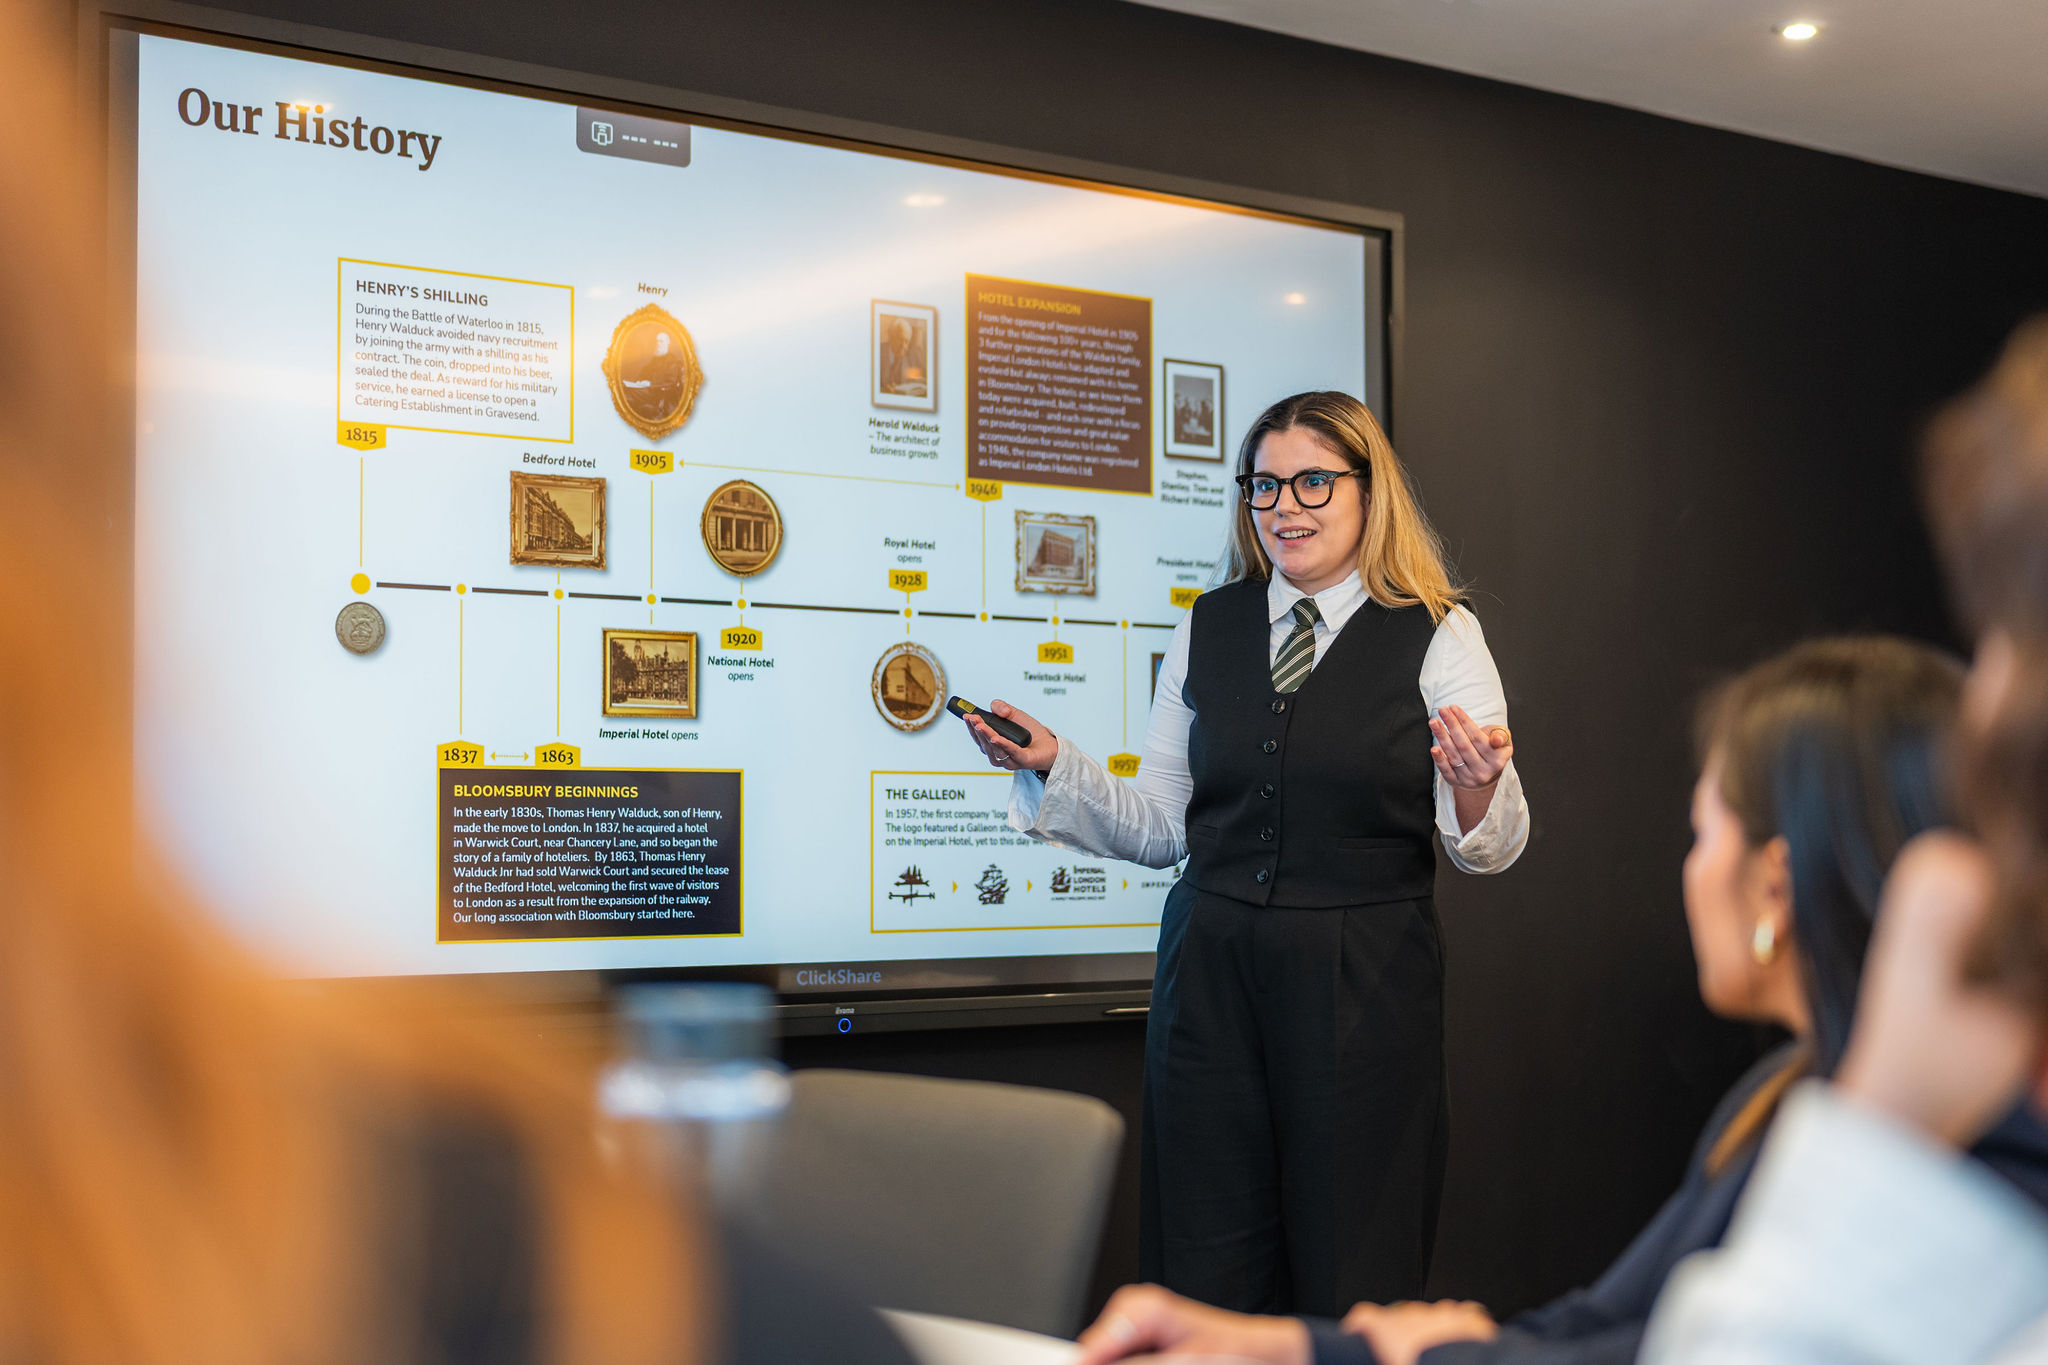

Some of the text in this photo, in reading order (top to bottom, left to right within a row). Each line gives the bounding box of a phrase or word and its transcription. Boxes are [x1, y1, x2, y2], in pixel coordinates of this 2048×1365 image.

[177, 87, 442, 171] Our History
[356, 281, 488, 307] HENRY'S SHILLING
[638, 282, 668, 297] Henry
[977, 293, 1081, 315] HOTEL EXPANSION
[355, 303, 544, 336] During the Battle of Waterloo in 1815,
[355, 318, 557, 350] Henry Walduck avoided navy recruitment
[354, 351, 552, 381] contract. The coin, dropped into his beer,
[354, 394, 539, 421] Catering Establishment in Gravesend.
[868, 418, 940, 432] Harold Walduck
[346, 428, 378, 444] 1815
[876, 432, 892, 441] The
[894, 434, 930, 445] architect
[932, 437, 940, 446] of
[870, 446, 938, 460] business growth
[523, 453, 596, 468] Bedford Hotel
[635, 454, 666, 468] 1905
[970, 483, 998, 496] 1946
[884, 538, 936, 550] Royal Hotel
[898, 554, 922, 564] opens
[895, 574, 922, 587] 1928
[727, 633, 756, 646] 1920
[1044, 648, 1068, 660] 1951
[708, 656, 774, 668] National Hotel
[728, 672, 754, 682] opens
[1024, 672, 1086, 682] Tavistock Hotel
[1043, 687, 1066, 696] opens
[599, 728, 698, 741] Imperial Hotel opens
[444, 748, 478, 764] 1837
[542, 750, 574, 765] 1863
[1114, 758, 1138, 770] 1957
[454, 785, 638, 798] BLOOMSBURY BEGINNINGS
[886, 789, 965, 800] THE GALLEON
[453, 806, 722, 822] In the early 1830s, Thomas Henry Walduck, son of Henry,
[885, 808, 893, 819] In
[895, 808, 918, 821] 1957,
[920, 808, 934, 819] the
[935, 808, 952, 819] first
[953, 811, 989, 822] company
[886, 822, 901, 833] The
[903, 822, 922, 836] logo
[923, 822, 958, 833] featured
[959, 825, 965, 833] a
[966, 822, 998, 833] Galleon
[453, 836, 717, 850] in Warwick Court, near Chancery Lane, and so began the
[884, 838, 896, 846] on
[897, 836, 911, 846] the
[913, 836, 946, 849] Imperial
[948, 836, 973, 848] Hotel,
[975, 836, 987, 849] yet
[989, 836, 998, 846] to
[999, 835, 1014, 846] this
[1015, 835, 1029, 849] day
[453, 864, 729, 877] Walduck Jnr had sold Warwick Court and secured the lease
[453, 879, 719, 894] of the Bedford Hotel, welcoming the first wave of visitors
[1074, 876, 1106, 884] LONDON
[1074, 885, 1106, 893] HOTELS
[452, 908, 695, 925] Our long association with Bloomsbury started here.
[796, 969, 882, 986] ClickShare
